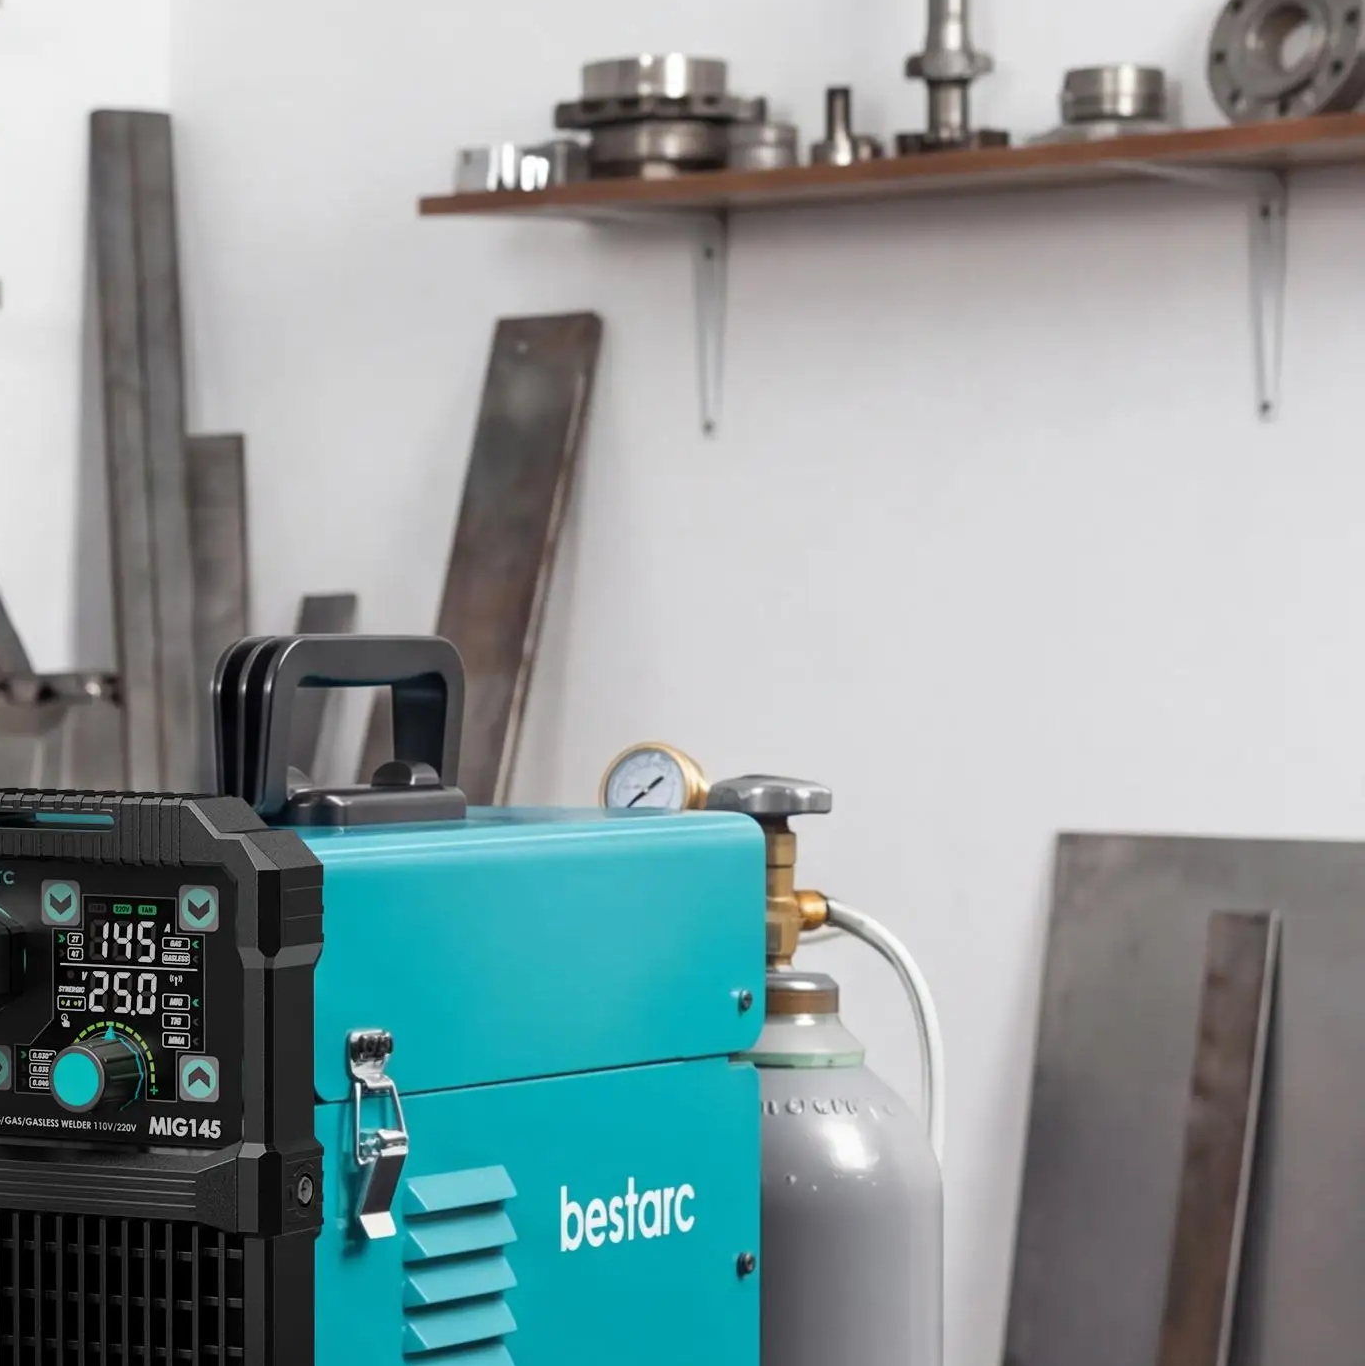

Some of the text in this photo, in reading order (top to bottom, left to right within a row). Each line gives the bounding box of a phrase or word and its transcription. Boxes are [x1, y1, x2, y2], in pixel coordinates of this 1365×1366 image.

[101, 920, 156, 963] 145
[169, 998, 183, 1006] MIG
[61, 1118, 92, 1130] WELDER
[93, 1121, 137, 1132] 110V/220V
[148, 1115, 222, 1139] MIG145
[560, 1176, 696, 1252] bestarc
